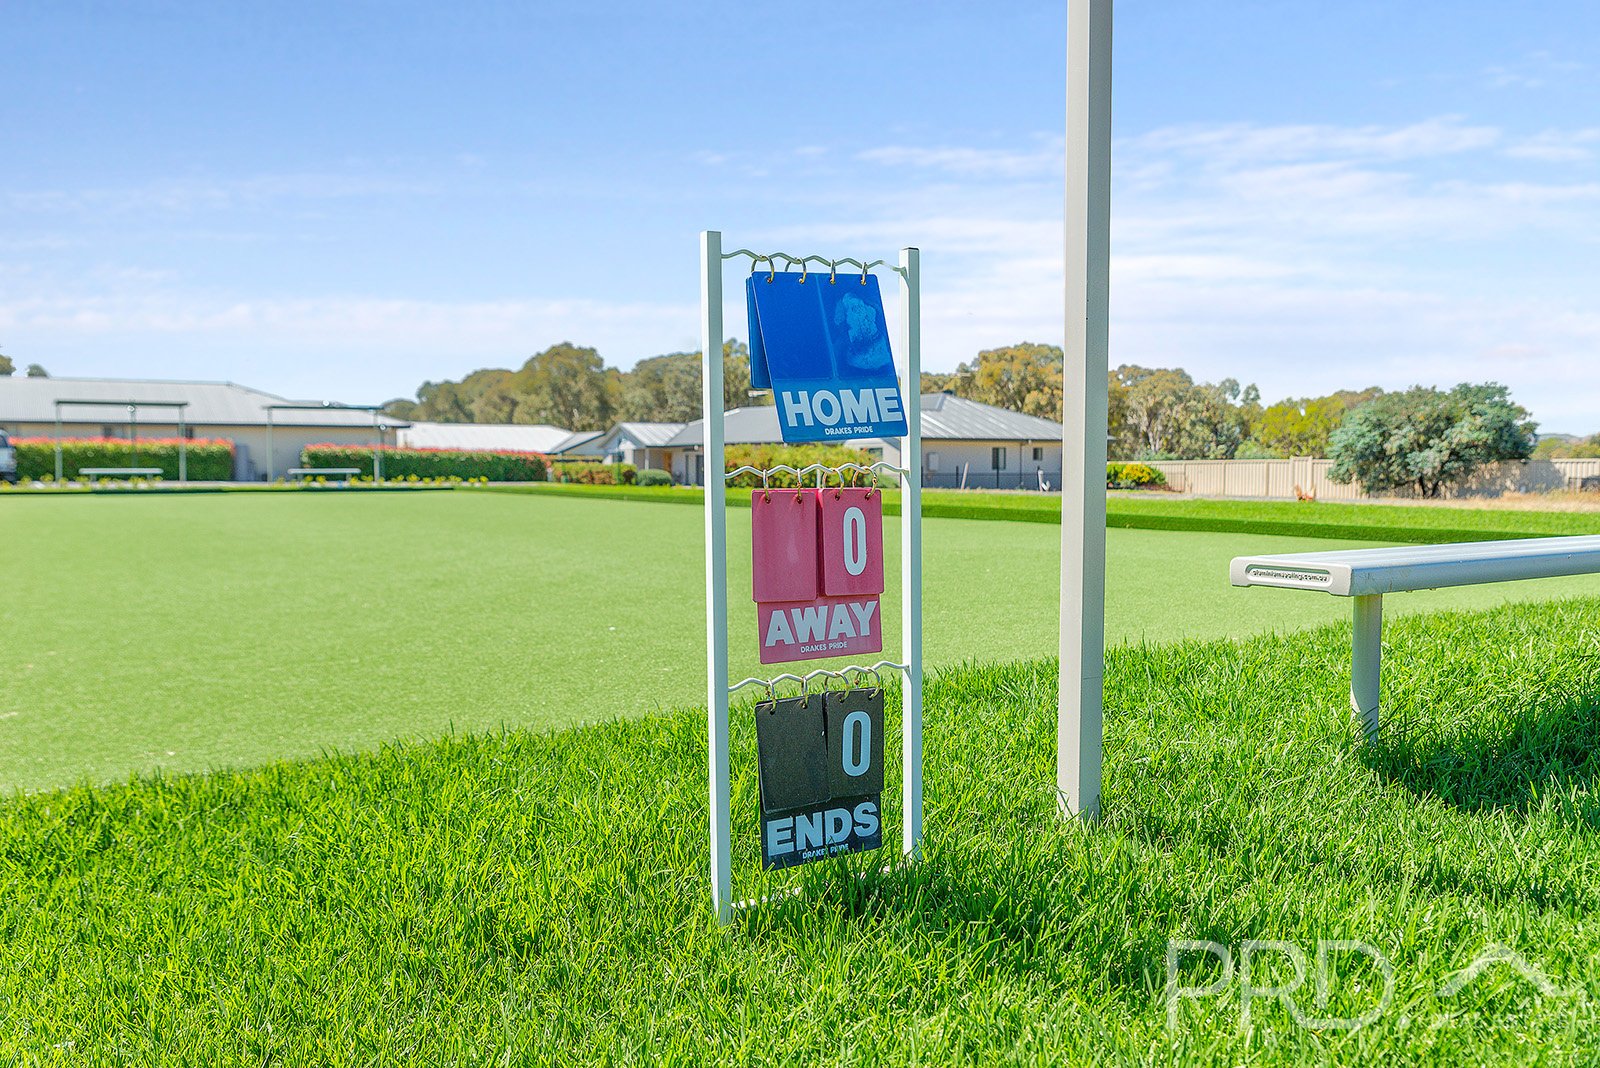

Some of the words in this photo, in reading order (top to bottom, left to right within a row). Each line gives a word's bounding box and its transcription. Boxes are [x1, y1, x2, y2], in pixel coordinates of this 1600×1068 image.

[782, 387, 903, 427] HOME
[824, 426, 852, 435] DRAKES
[854, 425, 874, 434] PRIDE
[843, 506, 867, 576] 0
[765, 600, 878, 647] AWAY
[800, 643, 827, 653] DRAKES
[828, 641, 848, 650] PRIDE
[842, 710, 872, 777] 0
[766, 801, 879, 857] ENDS
[802, 846, 829, 860] DRAKE
